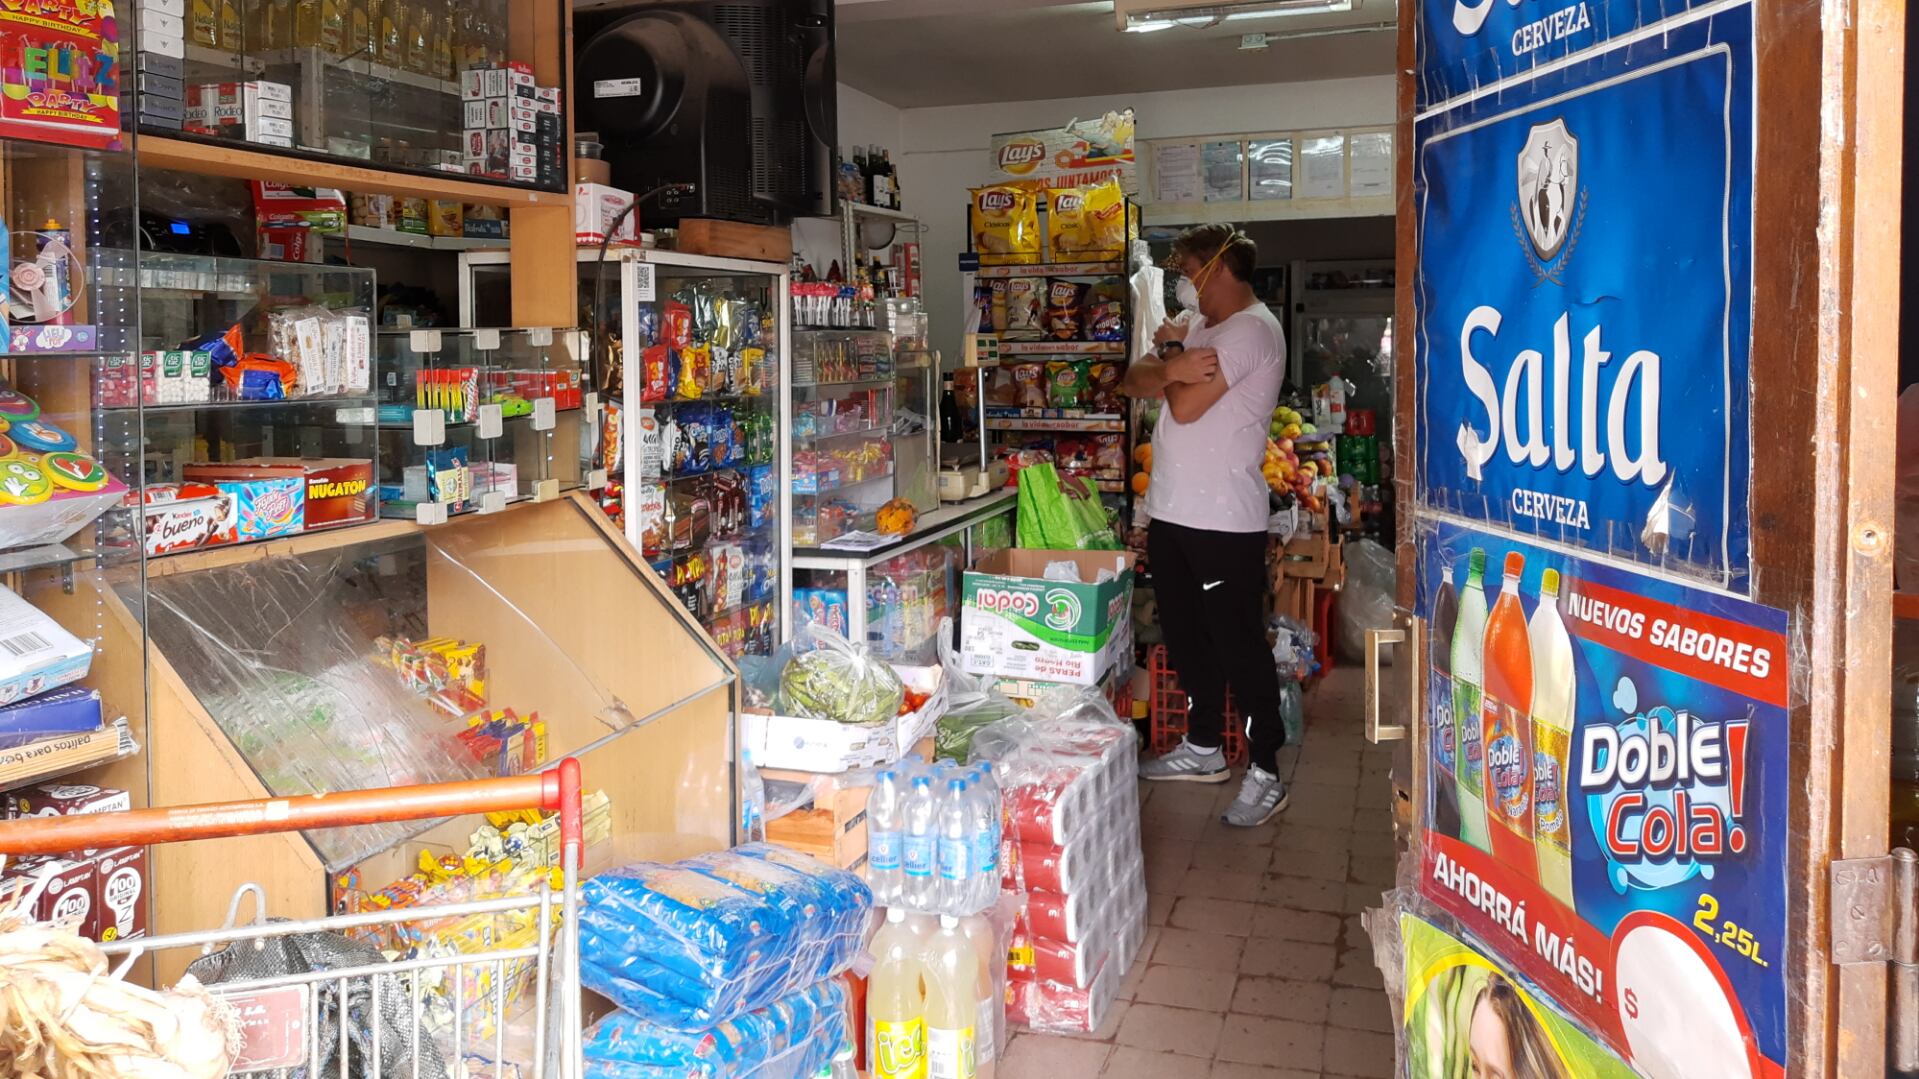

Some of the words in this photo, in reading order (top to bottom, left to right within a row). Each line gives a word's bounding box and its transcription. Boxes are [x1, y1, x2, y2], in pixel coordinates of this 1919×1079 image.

[12, 14, 41, 26] HAPPY
[42, 20, 82, 33] BIRTHDAY
[1512, 1, 1591, 56] CERVEZA
[26, 92, 100, 113] PARTY
[58, 111, 87, 119] BIRTHDAY
[184, 109, 207, 119] odeo
[293, 232, 303, 260] Colg
[1456, 305, 1667, 486] Salta
[308, 479, 366, 500] NUGATON
[172, 511, 192, 519] Kinder
[1512, 488, 1591, 529] CERVEZA
[162, 515, 204, 540] bueno
[978, 588, 1038, 616] Codai
[1568, 592, 1646, 639] NUEVOS
[1649, 618, 1771, 679] SABORES
[1049, 668, 1081, 677] PERAS
[53, 734, 91, 752] palitos
[1462, 726, 1480, 742] Dobl
[26, 745, 52, 759] para
[1488, 745, 1519, 767] Doble
[1581, 710, 1722, 787] Doble
[110, 876, 135, 897] 100
[57, 896, 84, 918] 100
[1433, 852, 1529, 946] AHORRÁ
[1535, 921, 1603, 1003] MÁS!
[1624, 987, 1639, 1019] $
